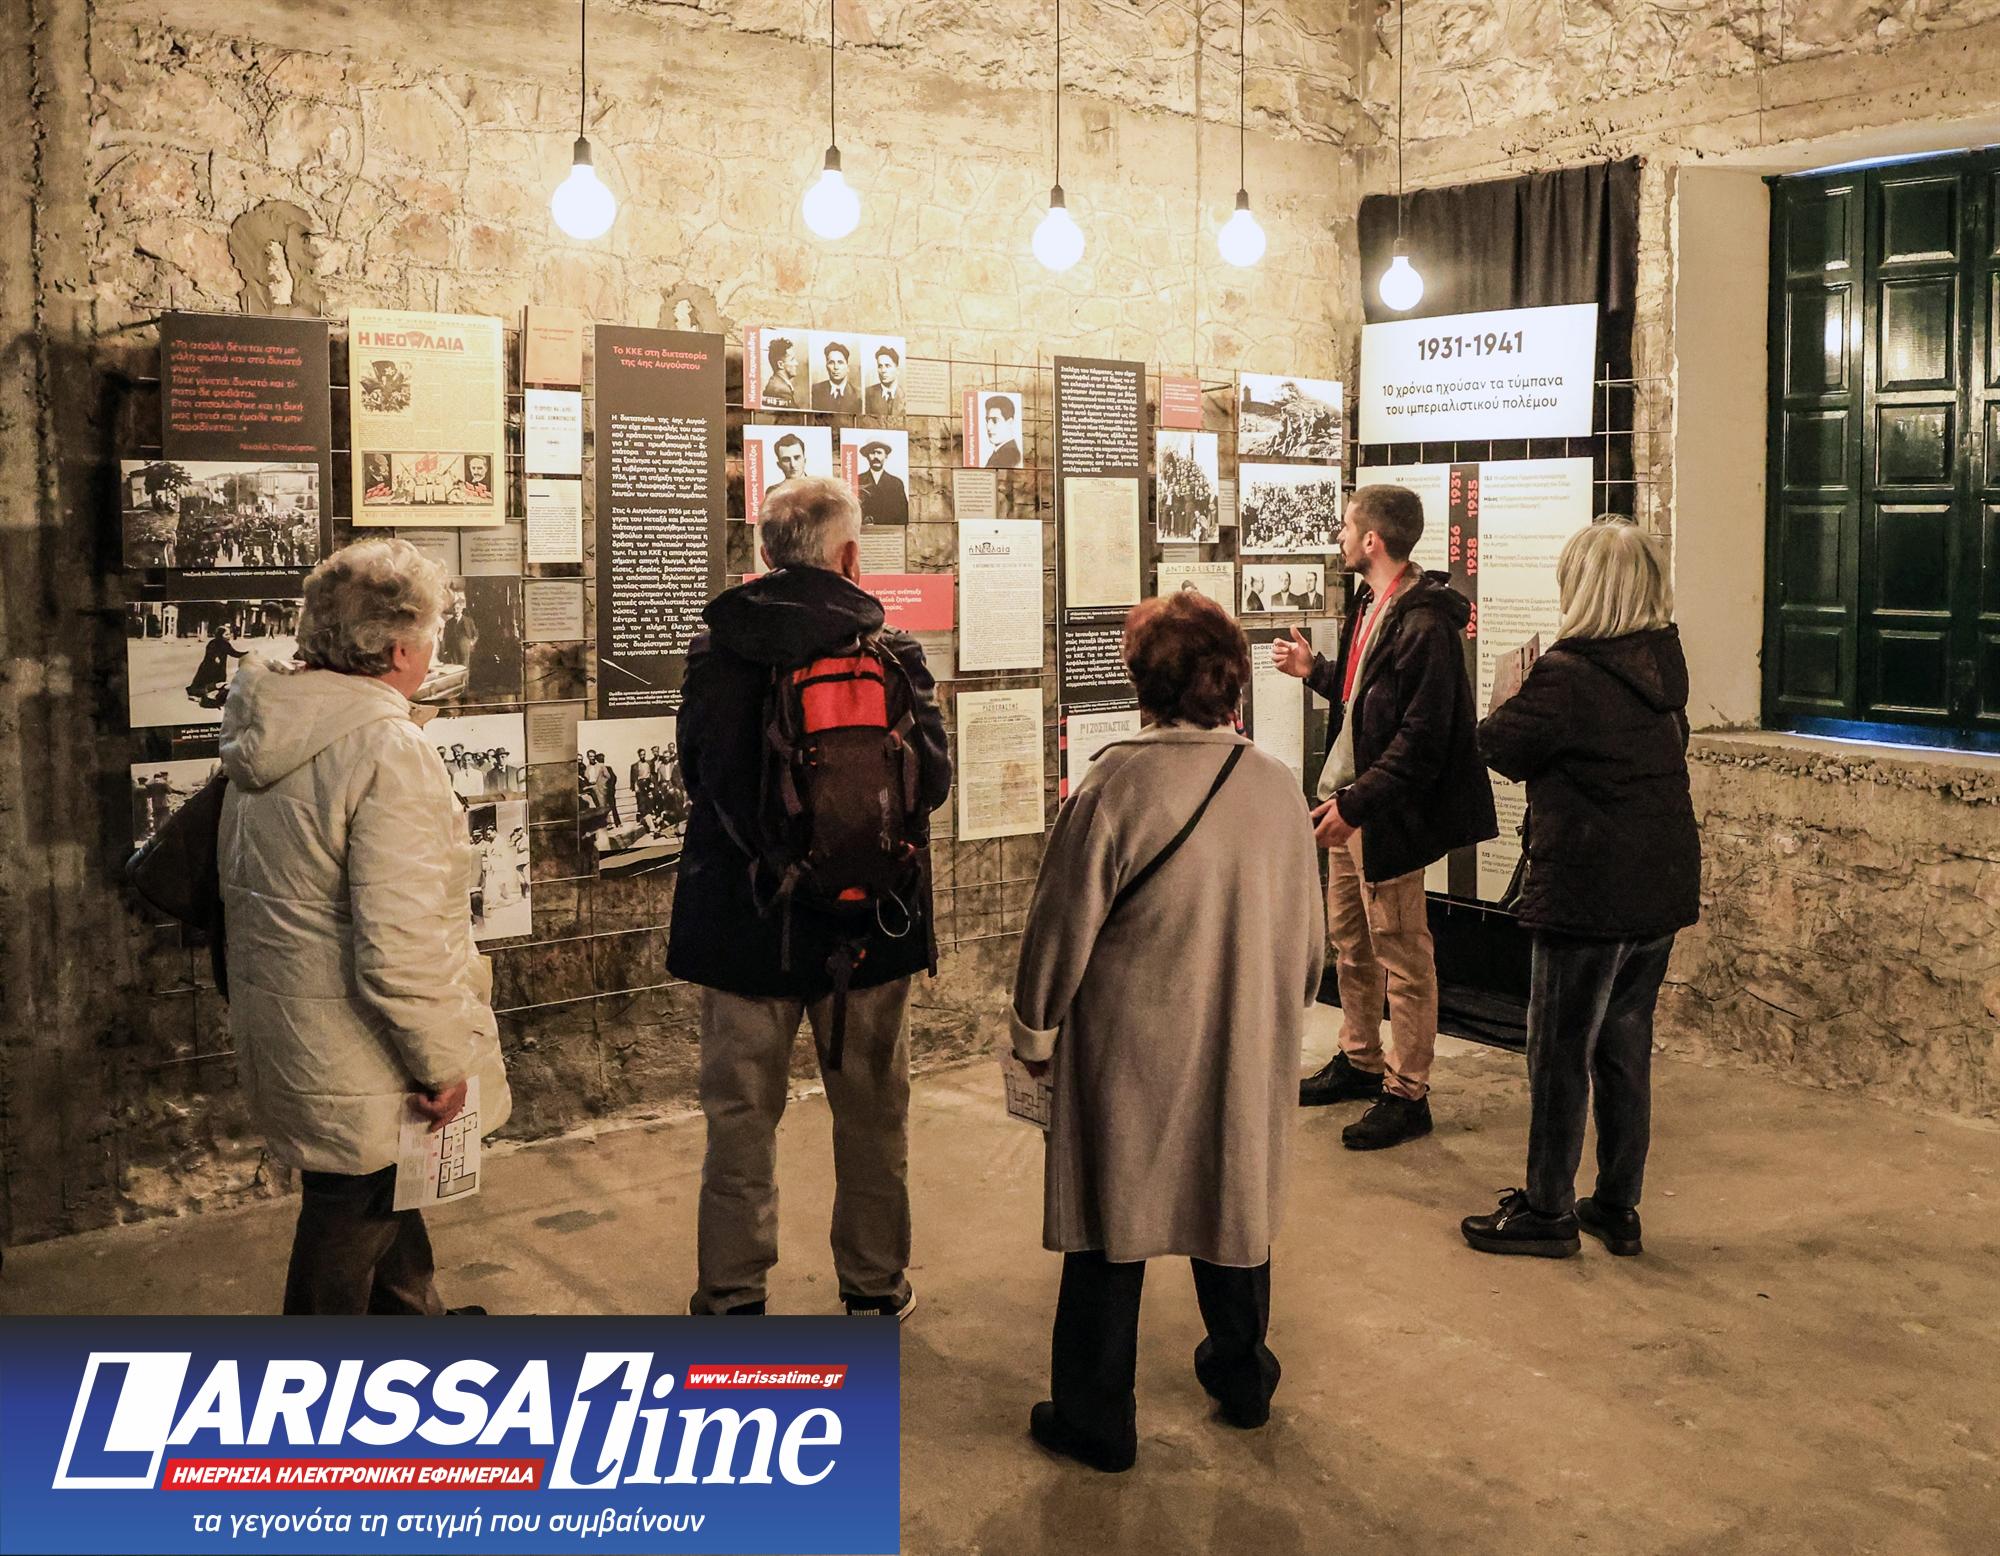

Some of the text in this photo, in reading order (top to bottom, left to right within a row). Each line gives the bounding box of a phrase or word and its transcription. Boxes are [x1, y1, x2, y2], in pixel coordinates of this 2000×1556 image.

[358, 331, 370, 346] Η
[1418, 330, 1523, 360] 1931-1941
[612, 346, 708, 360] Το ΚΚΕ στη δικτατορία
[620, 359, 700, 370] της 4ης Αυγούστου
[1383, 374, 1563, 398] 10 χρόνια ηχούσαν τα τύμπανα
[1386, 394, 1557, 416] του ιμπεριαλιστικού πολέμου
[1450, 471, 1461, 506] 1931
[1467, 479, 1478, 518] 1935
[612, 523, 642, 531] διάταγμα
[643, 515, 667, 523] Μεταξά
[612, 540, 633, 548] δράση
[1450, 525, 1460, 562] 1936
[1466, 537, 1478, 576] 1938
